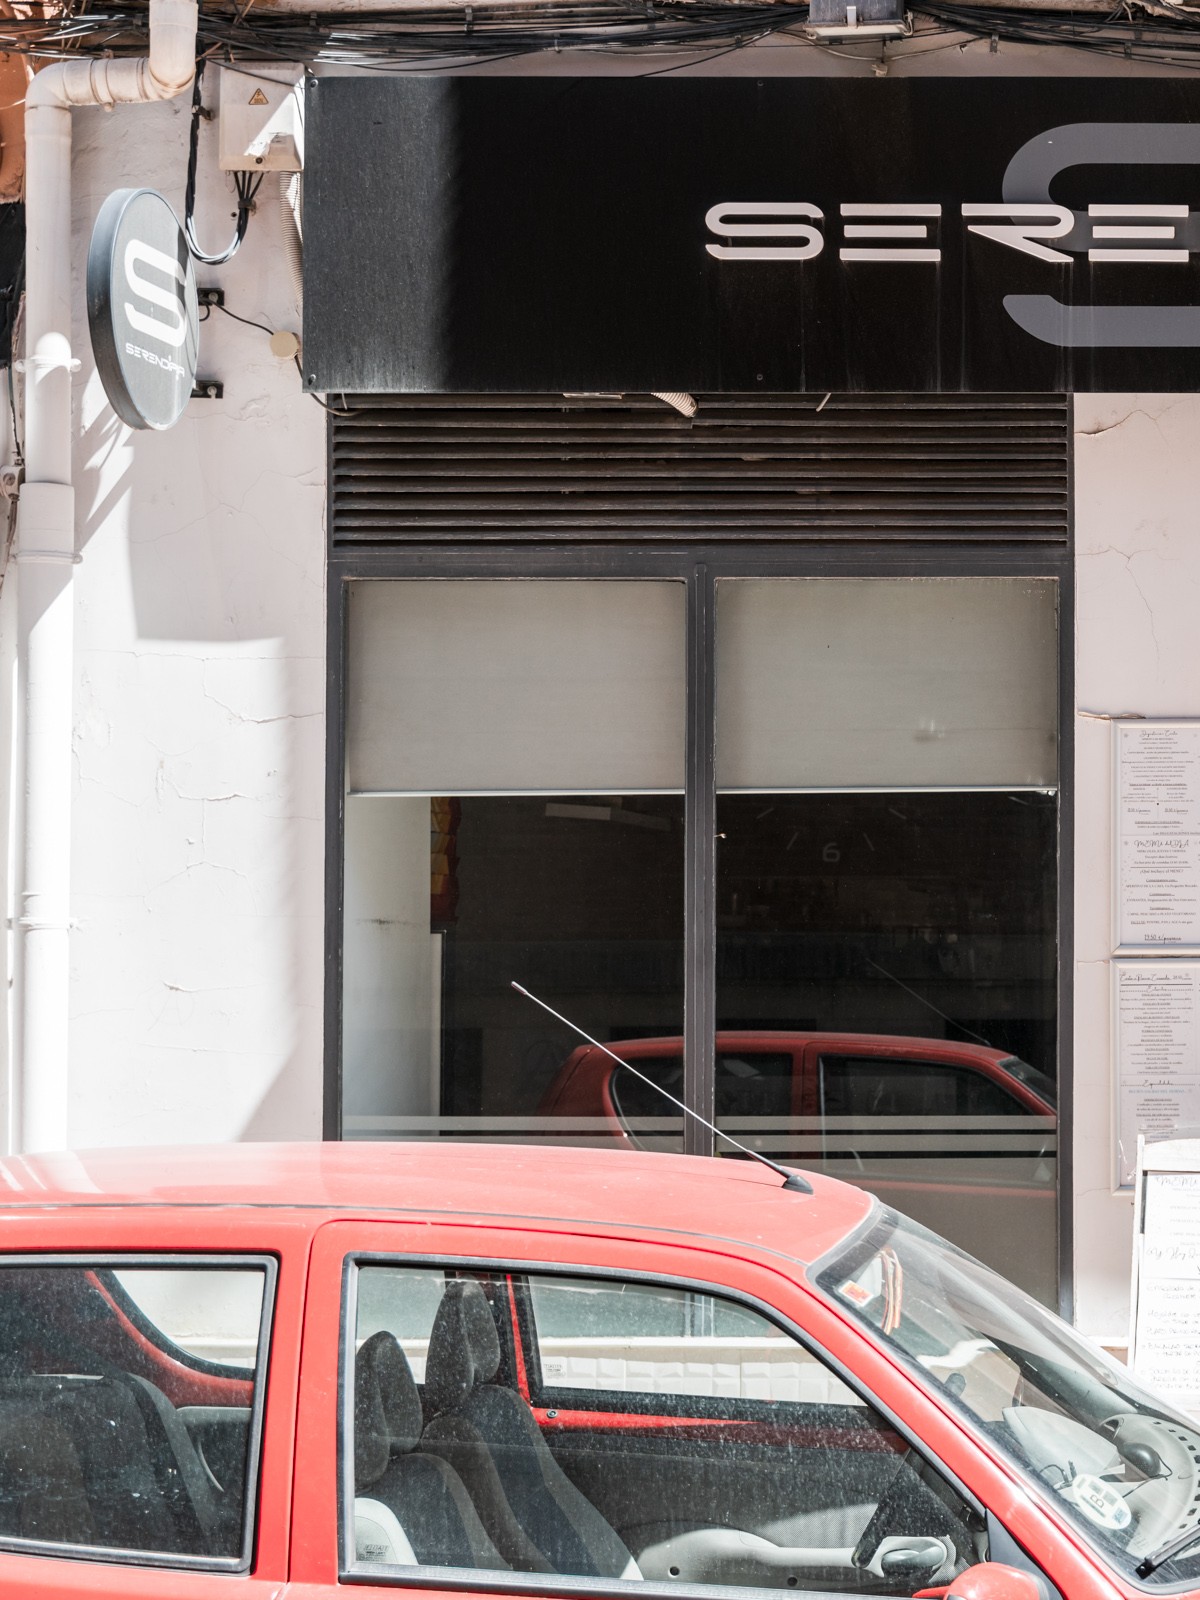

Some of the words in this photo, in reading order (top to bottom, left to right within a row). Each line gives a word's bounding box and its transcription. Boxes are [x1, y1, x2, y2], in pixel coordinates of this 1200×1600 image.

[124, 238, 187, 348] S
[823, 842, 840, 862] 6
[1090, 1494, 1105, 1508] B
